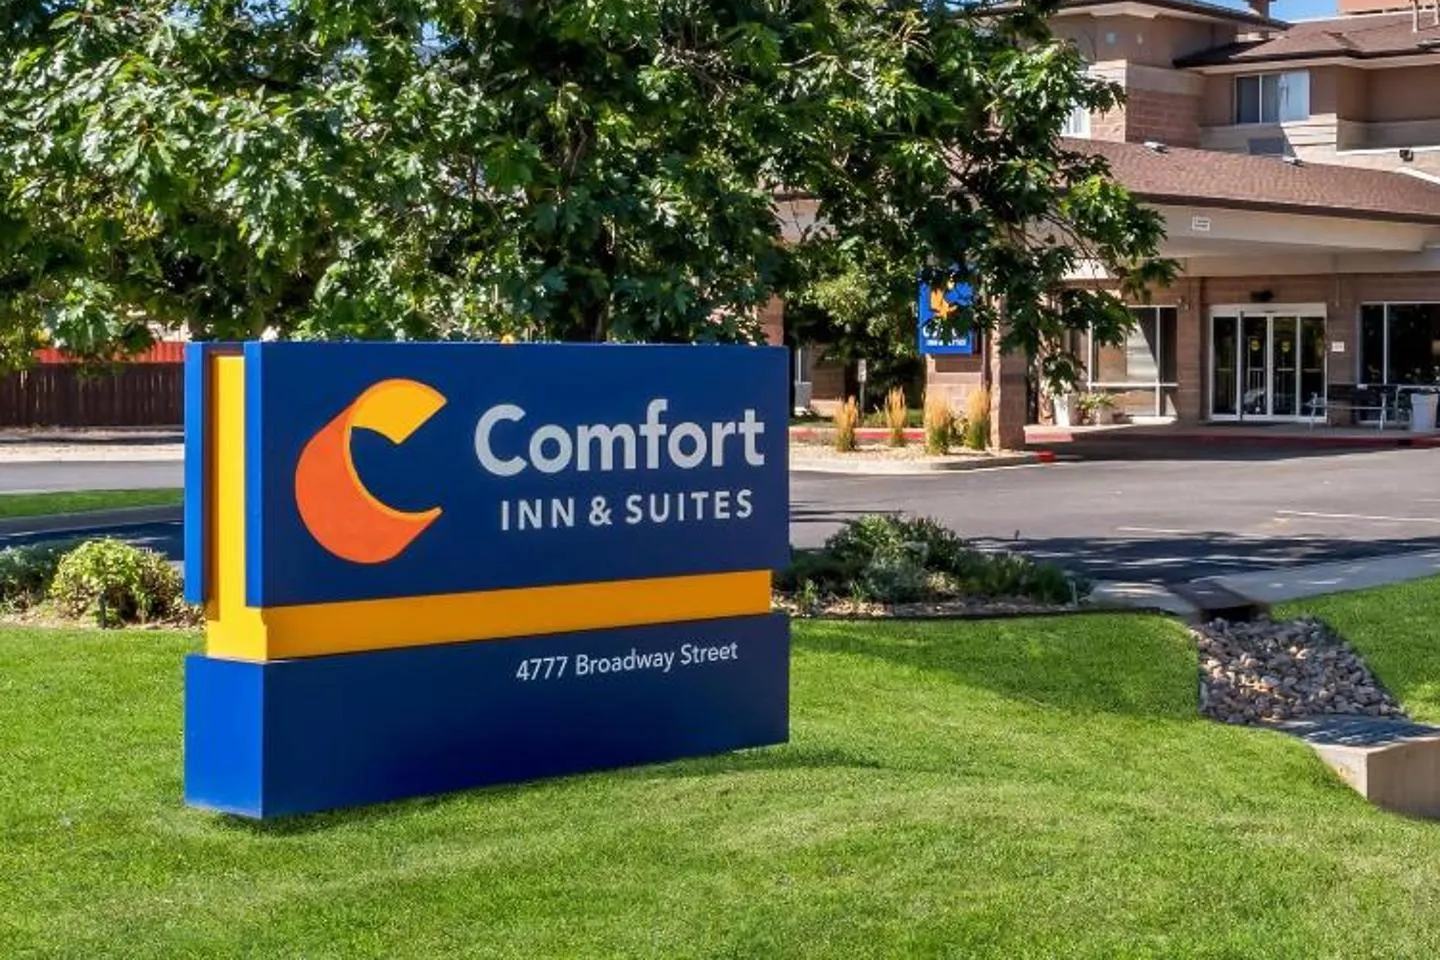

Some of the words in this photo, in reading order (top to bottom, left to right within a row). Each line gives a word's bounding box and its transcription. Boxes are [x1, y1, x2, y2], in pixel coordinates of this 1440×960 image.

[474, 398, 765, 477] Comfort
[502, 497, 575, 530] INN
[588, 495, 613, 526] &
[625, 488, 754, 525] SUITES
[516, 655, 569, 681] 4777
[575, 648, 675, 675] Broadway
[680, 642, 738, 665] Street
